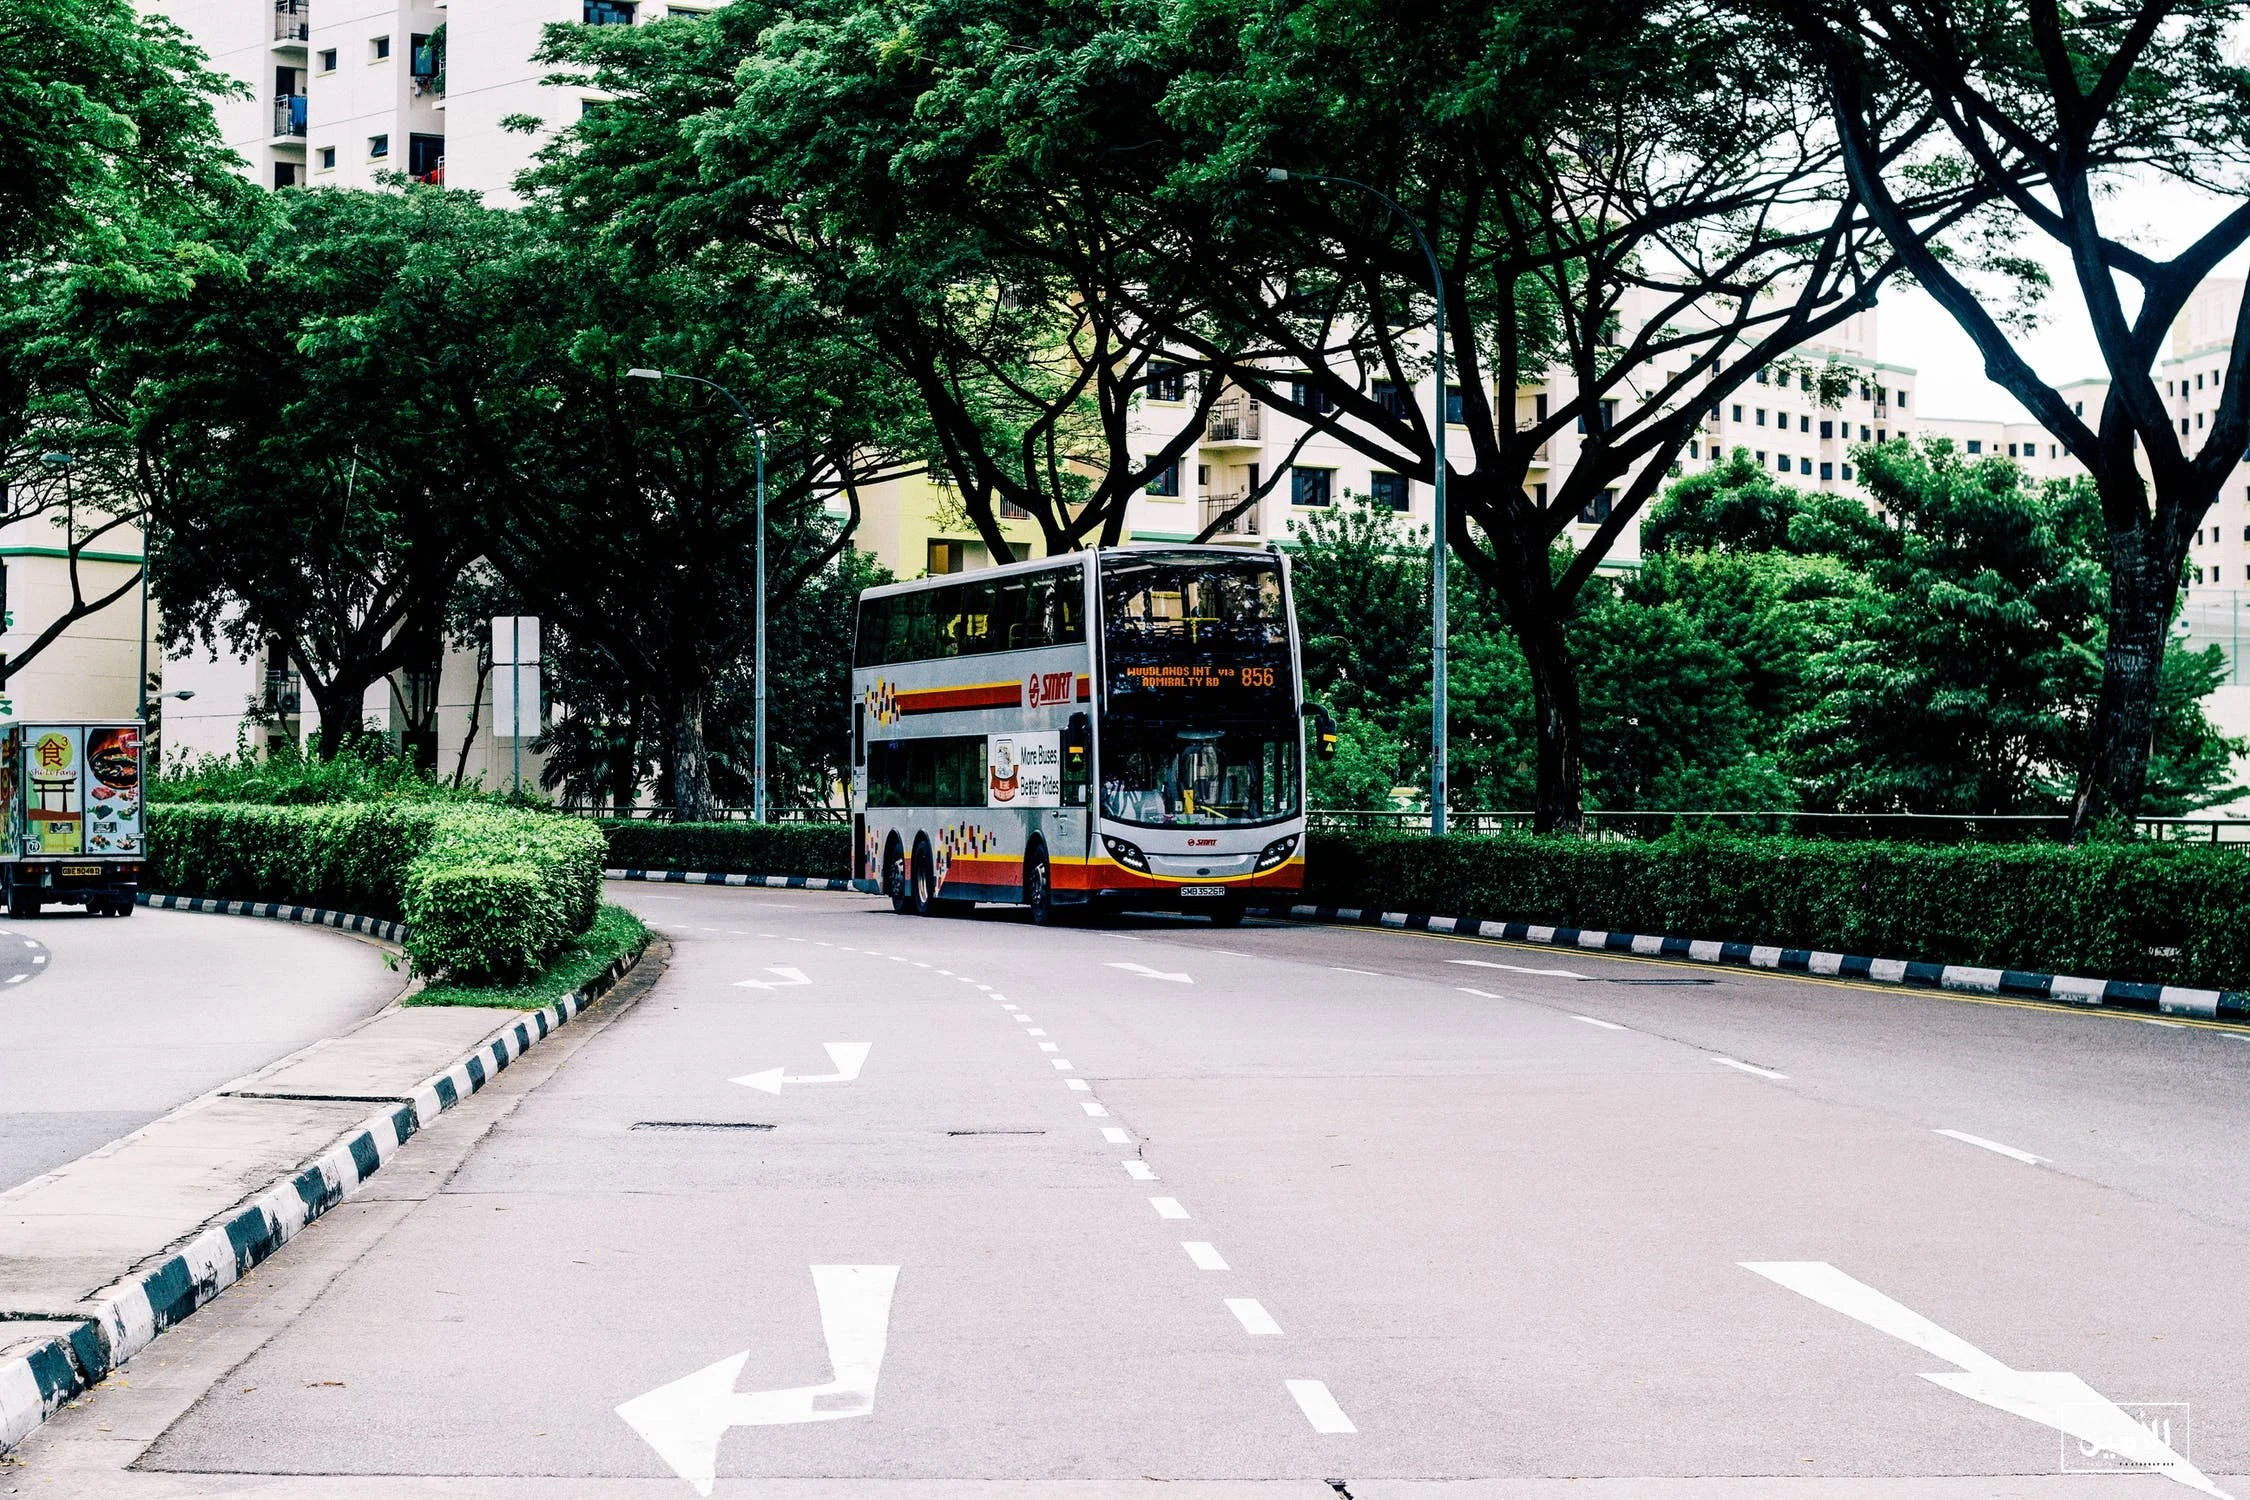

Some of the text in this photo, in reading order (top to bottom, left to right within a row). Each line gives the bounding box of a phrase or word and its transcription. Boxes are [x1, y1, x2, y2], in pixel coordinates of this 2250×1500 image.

[1192, 666, 1212, 676] INT
[1218, 668, 1235, 676] via
[1241, 667, 1274, 687] 856
[1040, 672, 1073, 702] SMRT
[1142, 677, 1220, 687] ADMIRALTY RD
[1020, 746, 1037, 765] More
[1020, 775, 1059, 796] Better Rides
